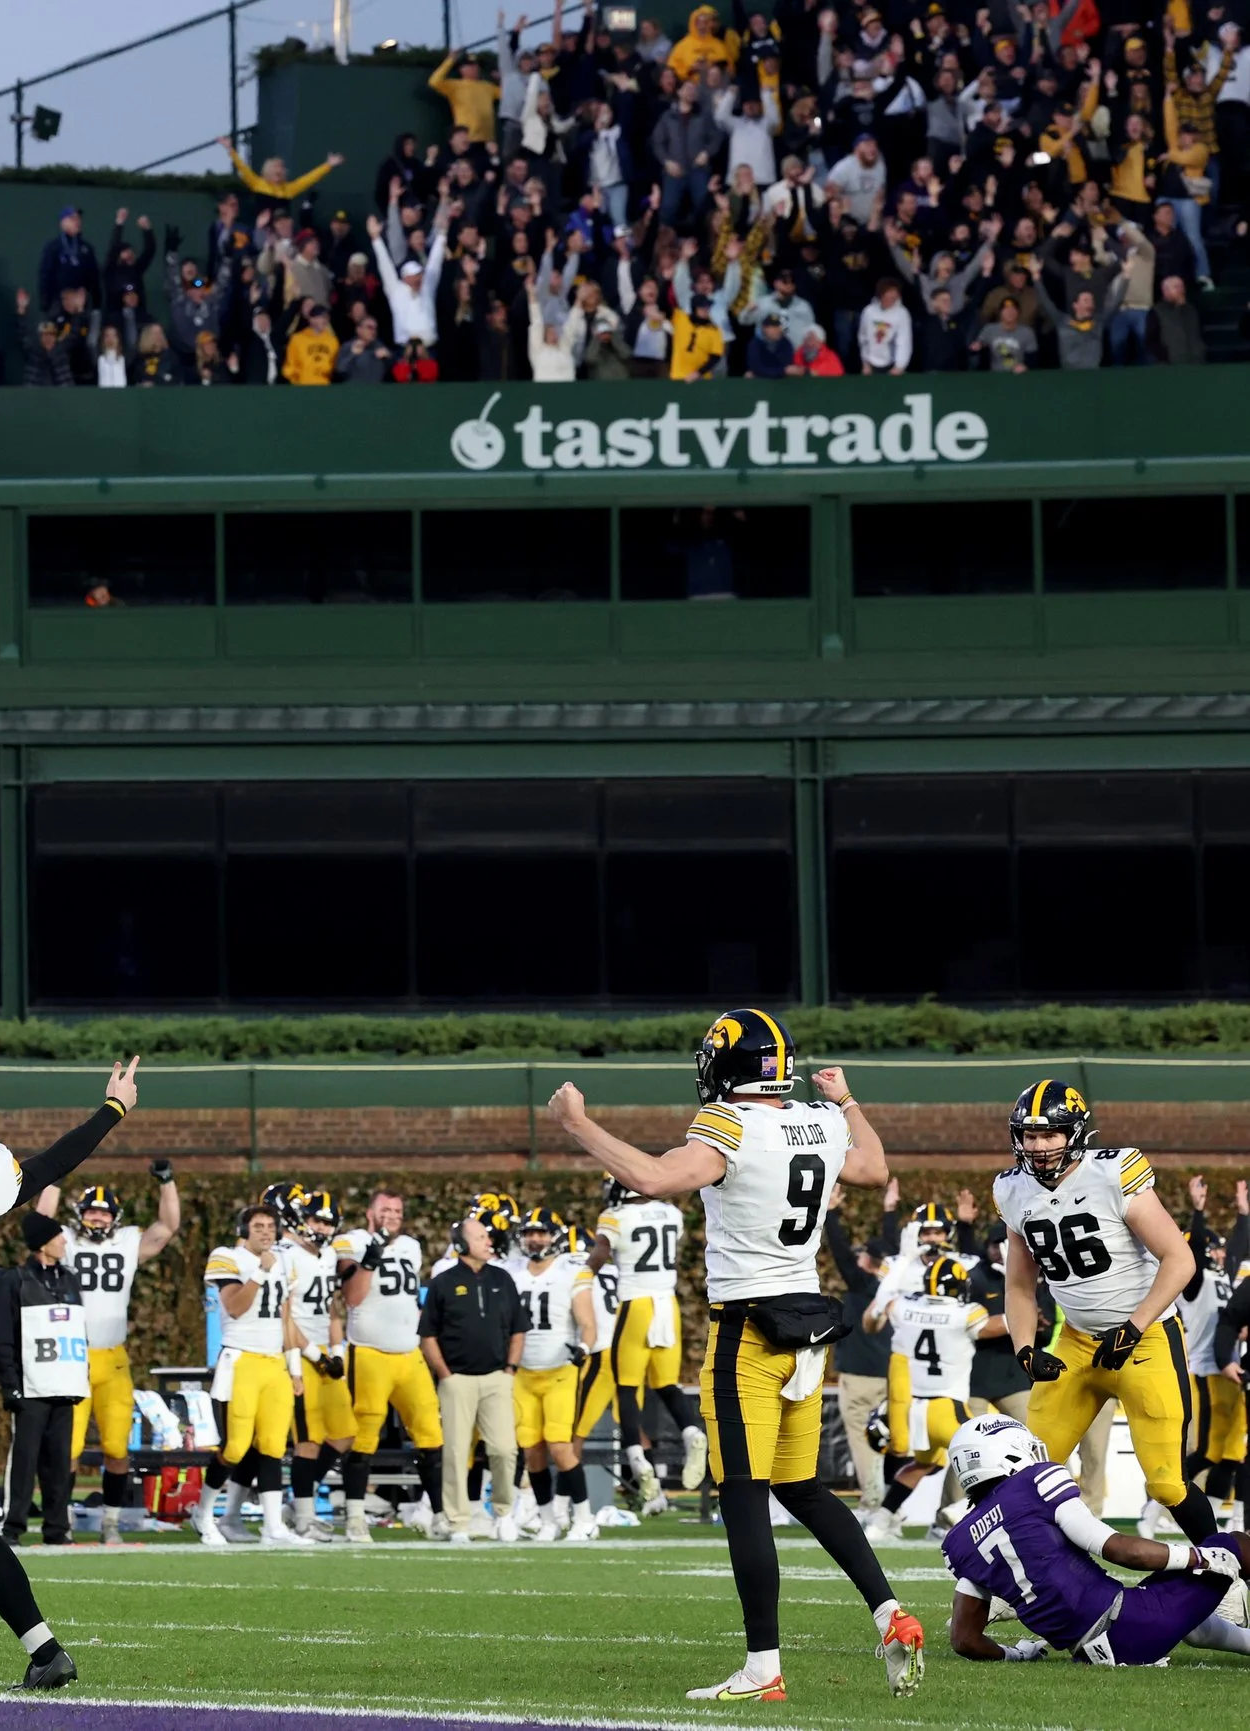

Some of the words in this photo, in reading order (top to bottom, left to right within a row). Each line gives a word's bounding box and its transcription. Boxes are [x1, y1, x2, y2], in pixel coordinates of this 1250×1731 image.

[781, 1123, 827, 1146] TAYLOR
[778, 1154, 825, 1247] 9
[631, 1224, 678, 1273] 20
[1024, 1212, 1112, 1282] 86
[74, 1252, 125, 1292] 88
[378, 1257, 418, 1297] 56
[258, 1279, 283, 1318] 11
[914, 1328, 943, 1376] 4
[977, 1525, 1038, 1605] 7
